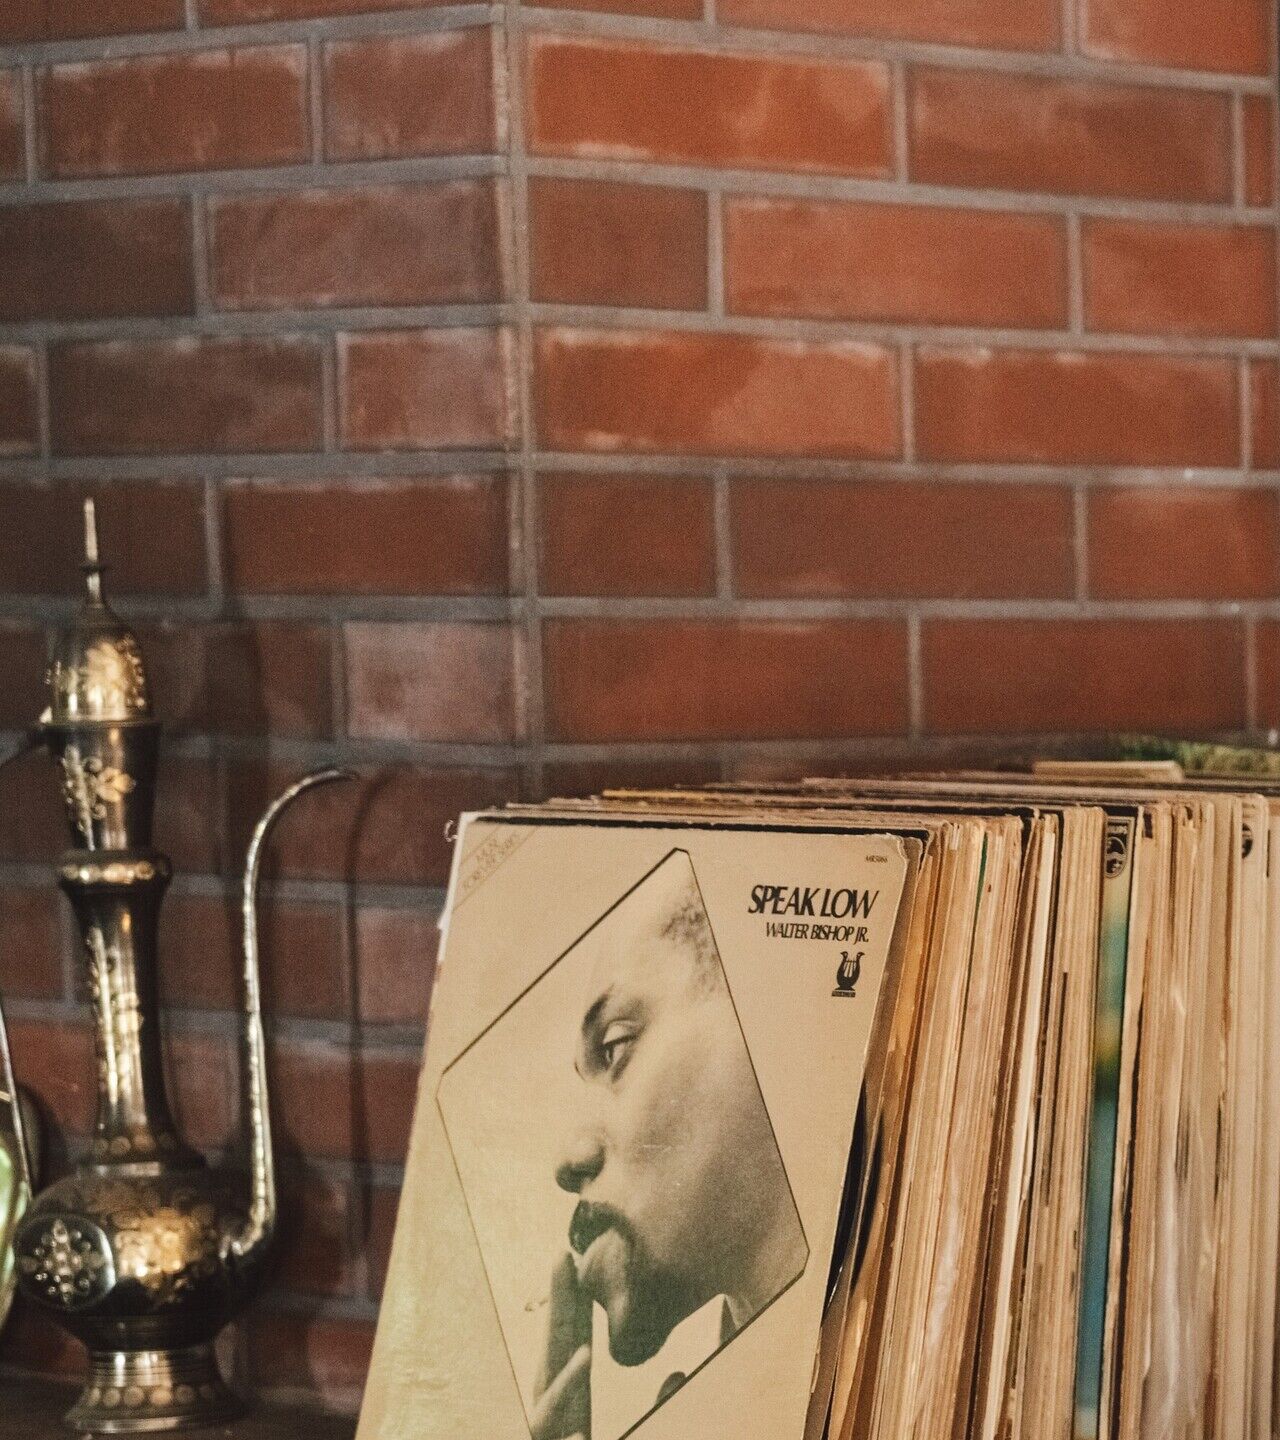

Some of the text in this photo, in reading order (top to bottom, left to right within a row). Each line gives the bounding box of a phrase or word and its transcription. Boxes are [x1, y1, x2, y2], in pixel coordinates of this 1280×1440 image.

[748, 884, 880, 919] SPEAK LOW
[766, 922, 869, 945] WALTER BISHOP JR.
